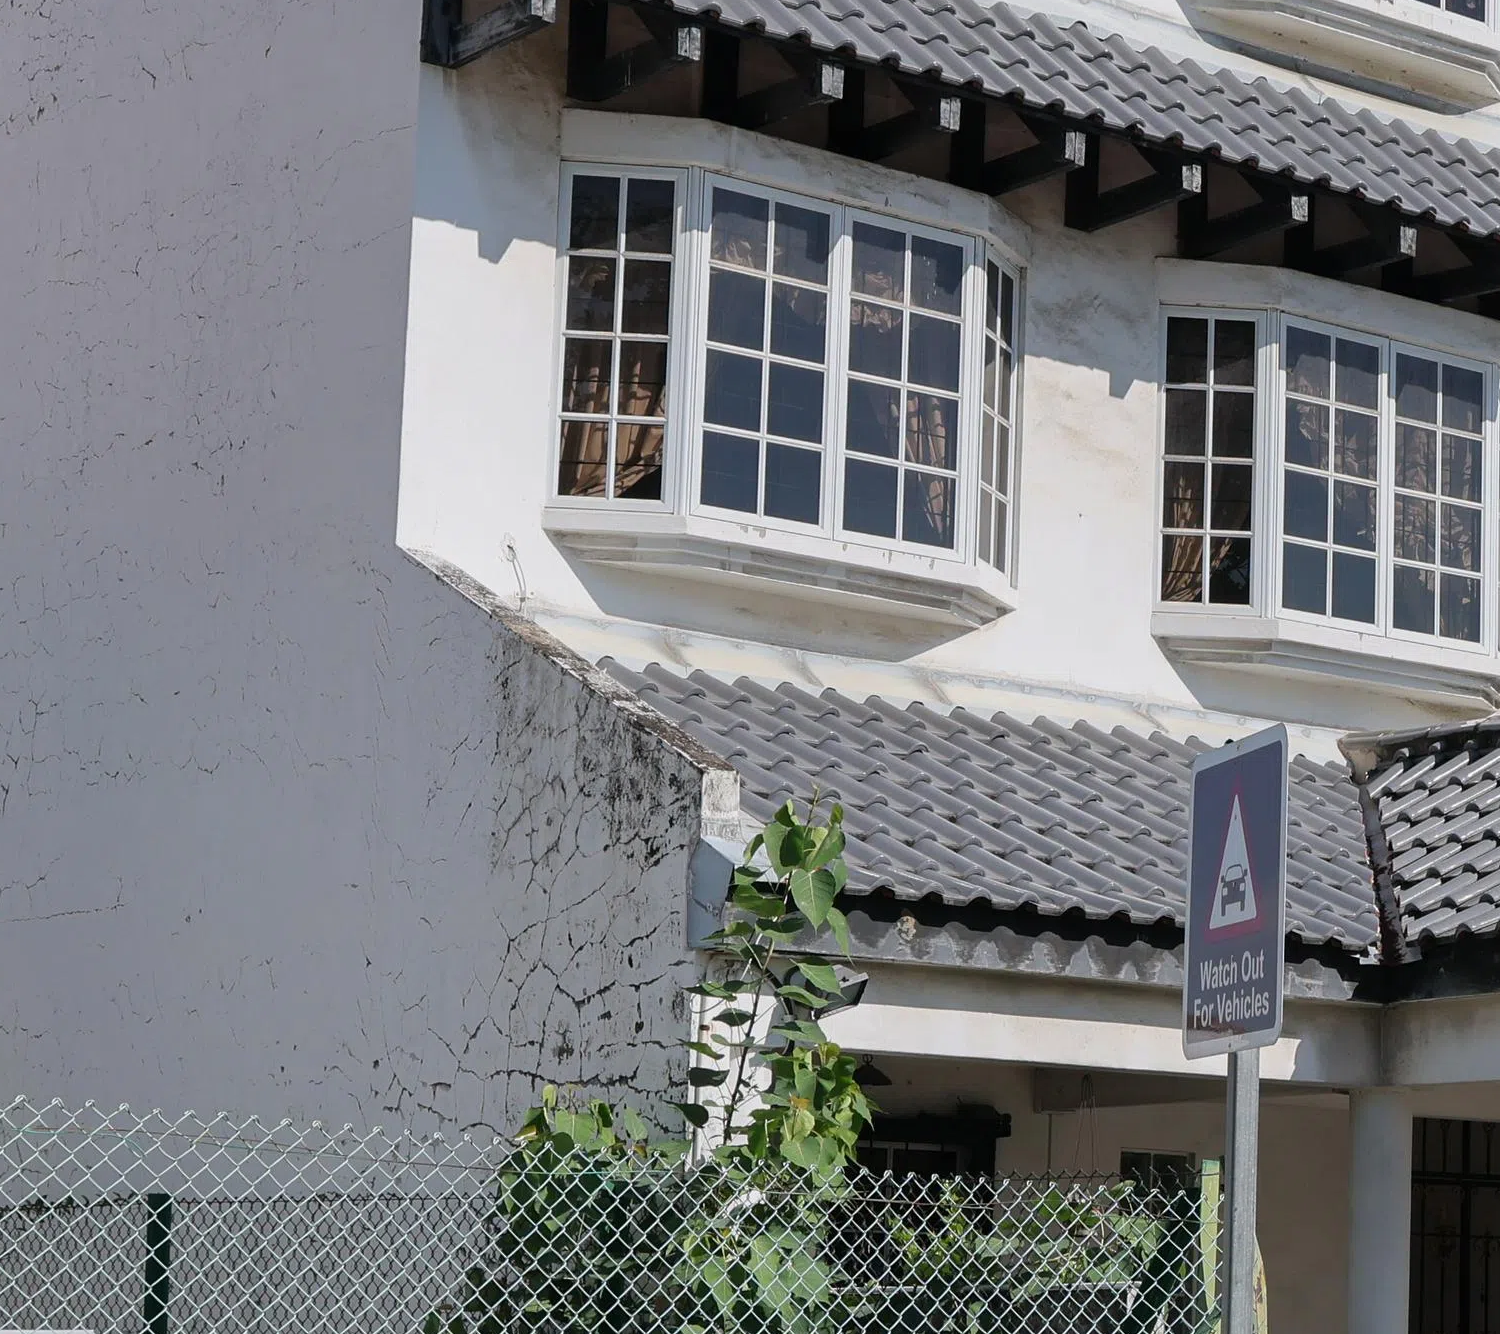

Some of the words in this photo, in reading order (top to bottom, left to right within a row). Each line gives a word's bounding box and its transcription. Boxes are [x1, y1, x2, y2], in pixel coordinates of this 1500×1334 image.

[1200, 955, 1237, 992] Watch
[1241, 949, 1265, 983] Out
[1194, 998, 1214, 1029] For
[1217, 987, 1270, 1024] Vehicles
